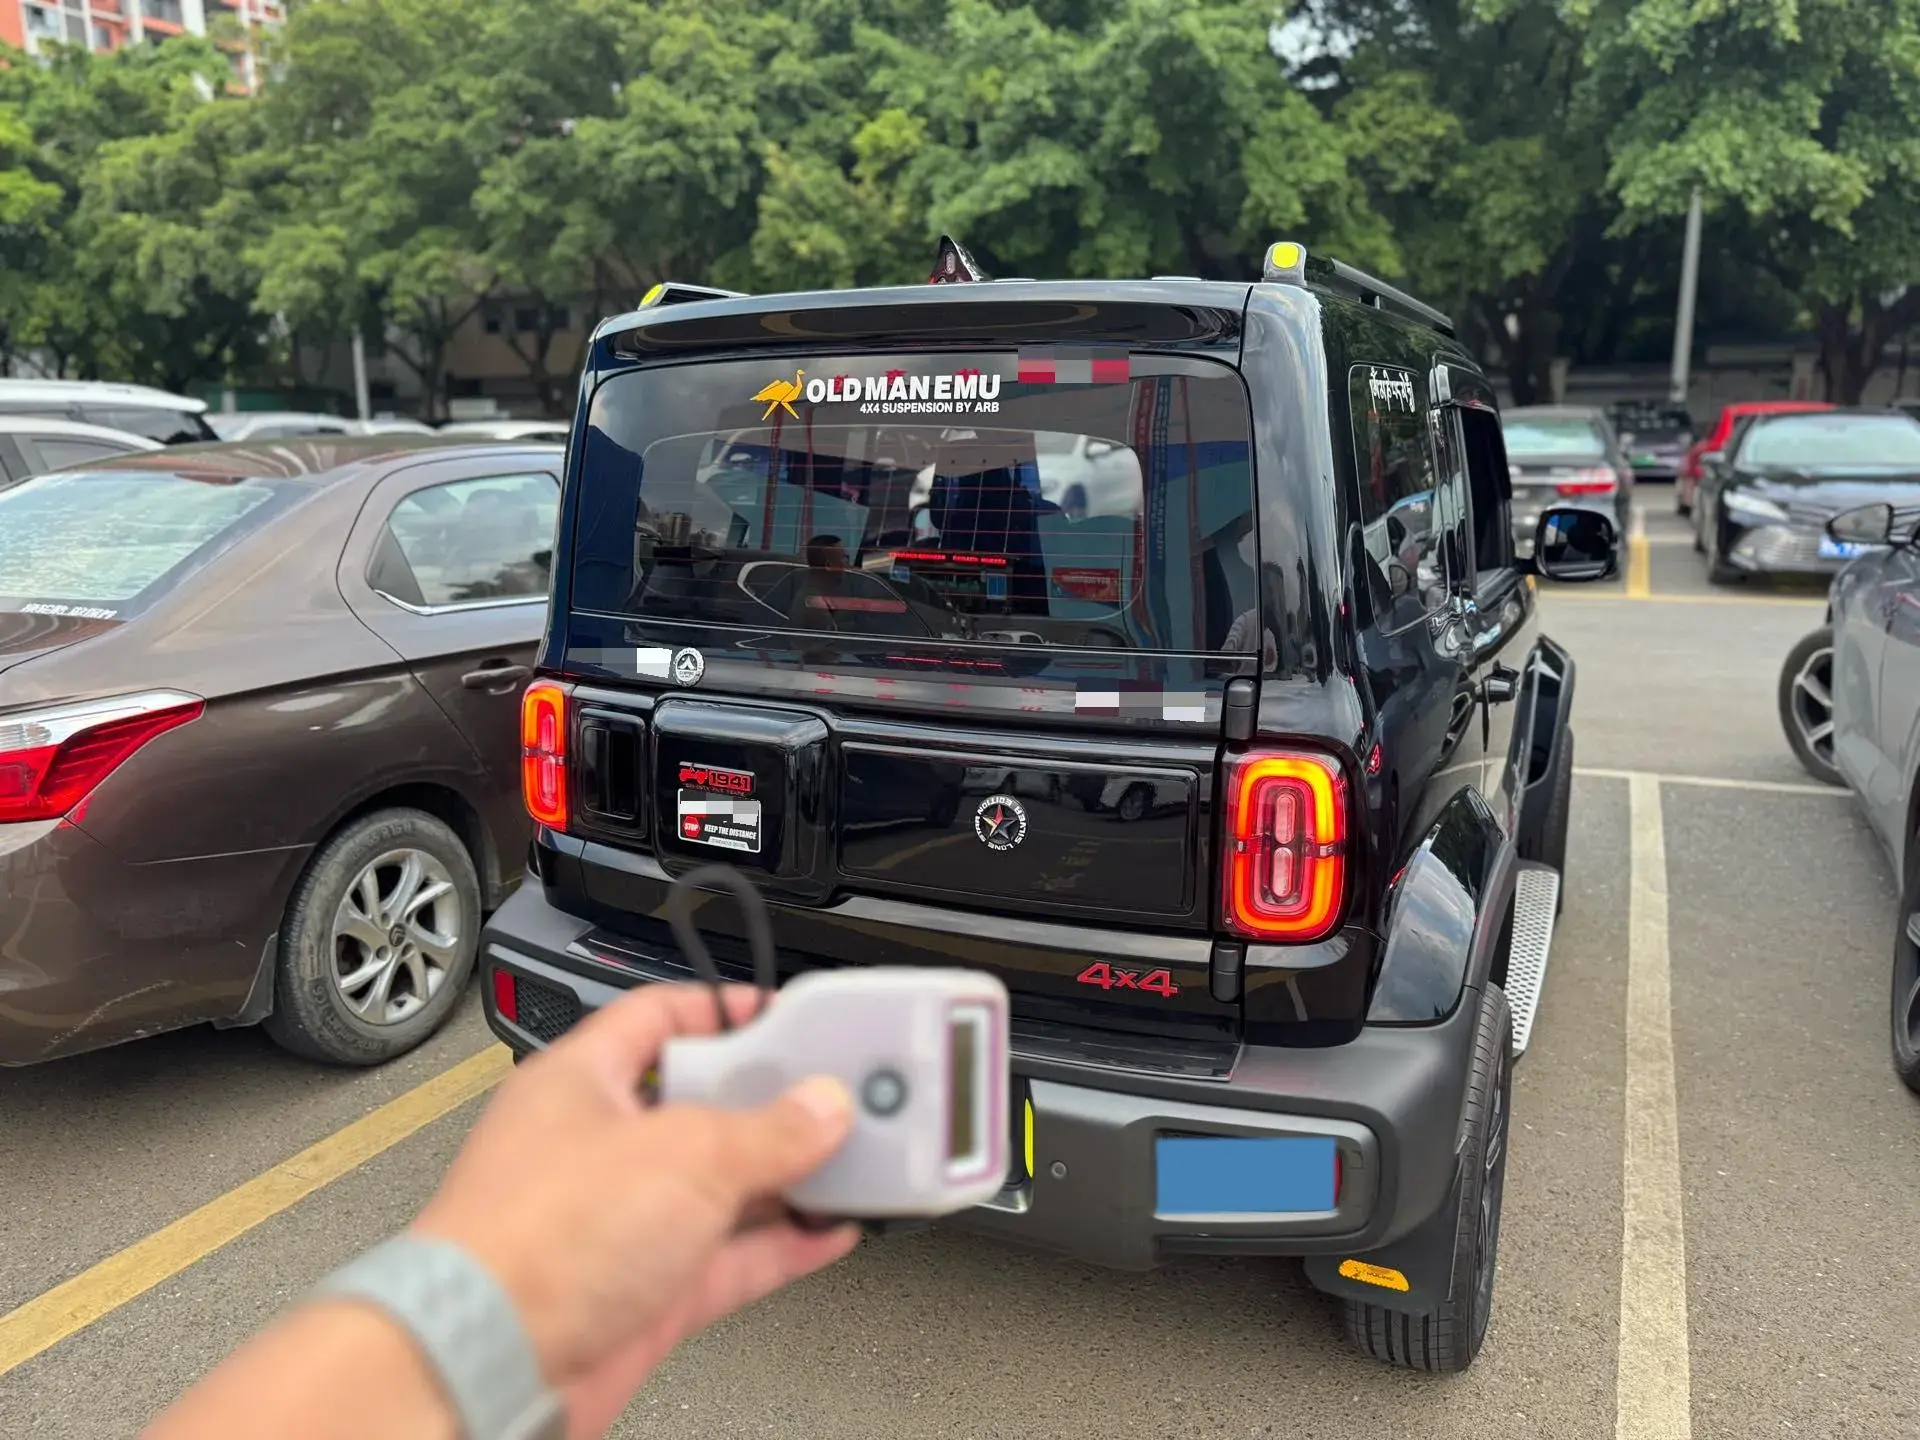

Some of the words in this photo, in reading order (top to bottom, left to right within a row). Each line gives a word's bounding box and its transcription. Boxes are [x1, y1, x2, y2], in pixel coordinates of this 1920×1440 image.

[806, 378, 862, 403] OLD
[865, 375, 931, 400] MAN
[934, 374, 1001, 400] EMU
[859, 403, 880, 414] 4X4
[882, 402, 953, 414] SUSPENSION
[955, 402, 972, 413] BY
[974, 401, 1000, 413] ARB
[709, 772, 749, 790] 1941
[977, 796, 1013, 815] EDITION
[684, 823, 699, 832] STOP
[704, 823, 718, 833] KEEP
[719, 825, 729, 835] THE
[729, 828, 757, 840] DISTANCE
[975, 815, 987, 842] STAR
[1014, 805, 1027, 844] SILVER
[987, 841, 1014, 851] LONE
